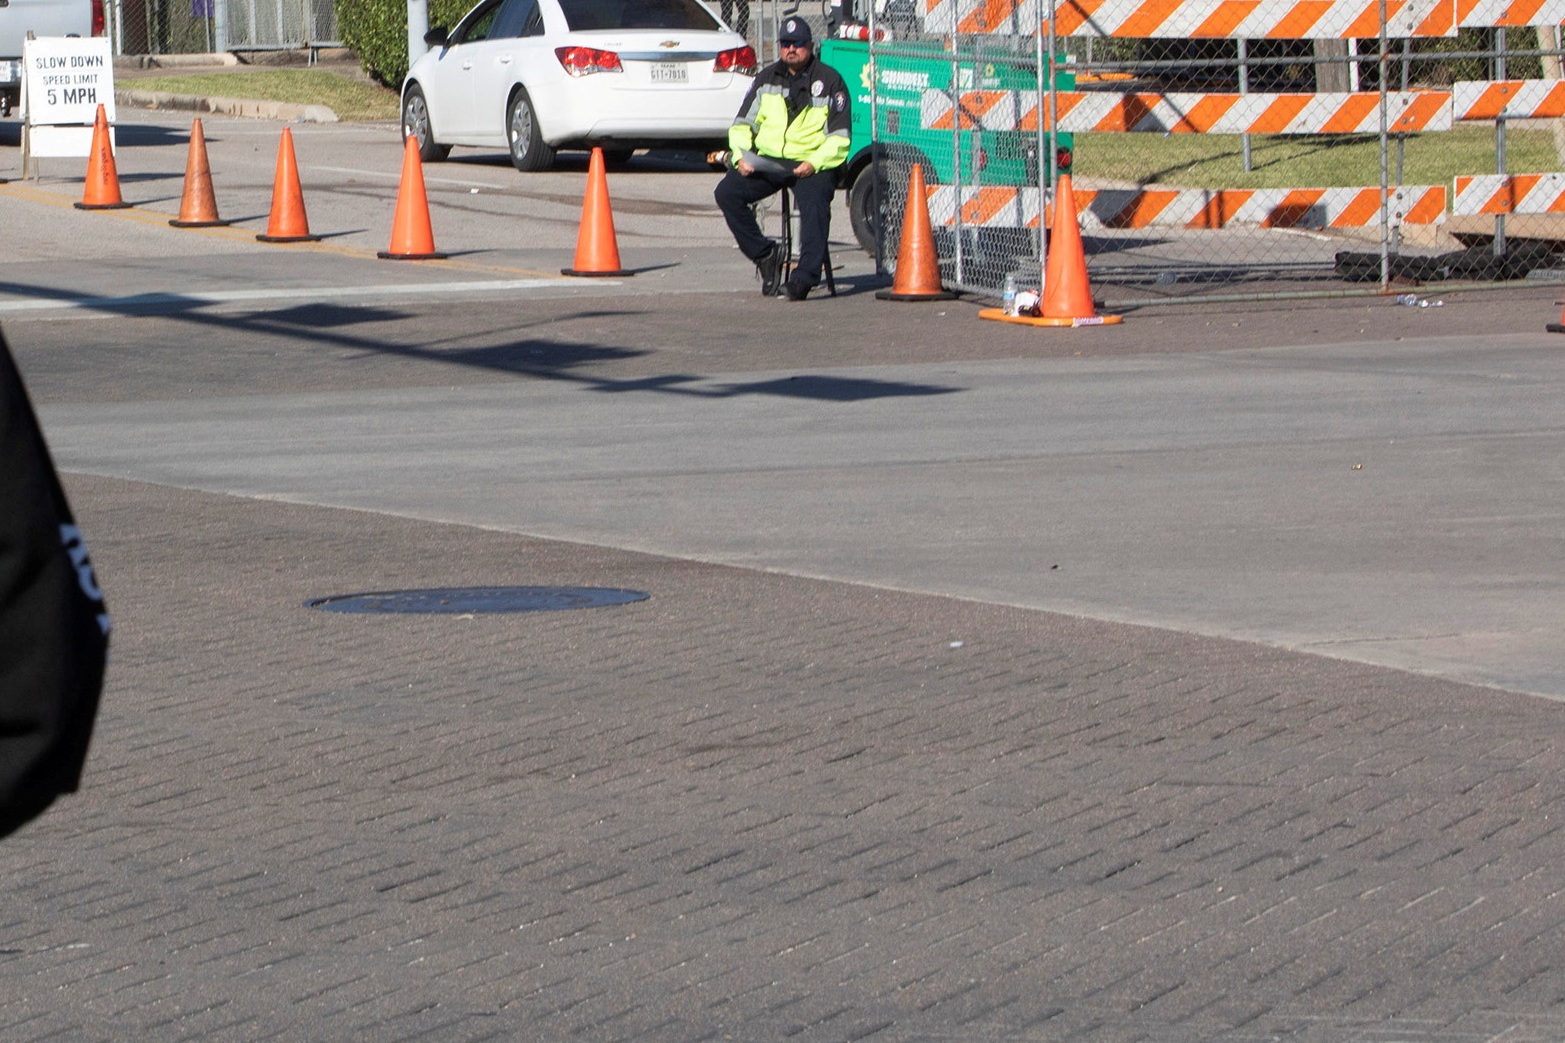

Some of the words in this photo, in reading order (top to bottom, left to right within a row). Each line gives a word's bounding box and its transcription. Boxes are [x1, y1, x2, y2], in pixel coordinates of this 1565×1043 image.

[35, 56, 67, 70] SLOW
[70, 55, 104, 68] DOWN
[42, 74, 71, 85] SPEED
[73, 73, 98, 85] LIMIT
[47, 88, 57, 106] 5
[63, 87, 97, 105] MPH
